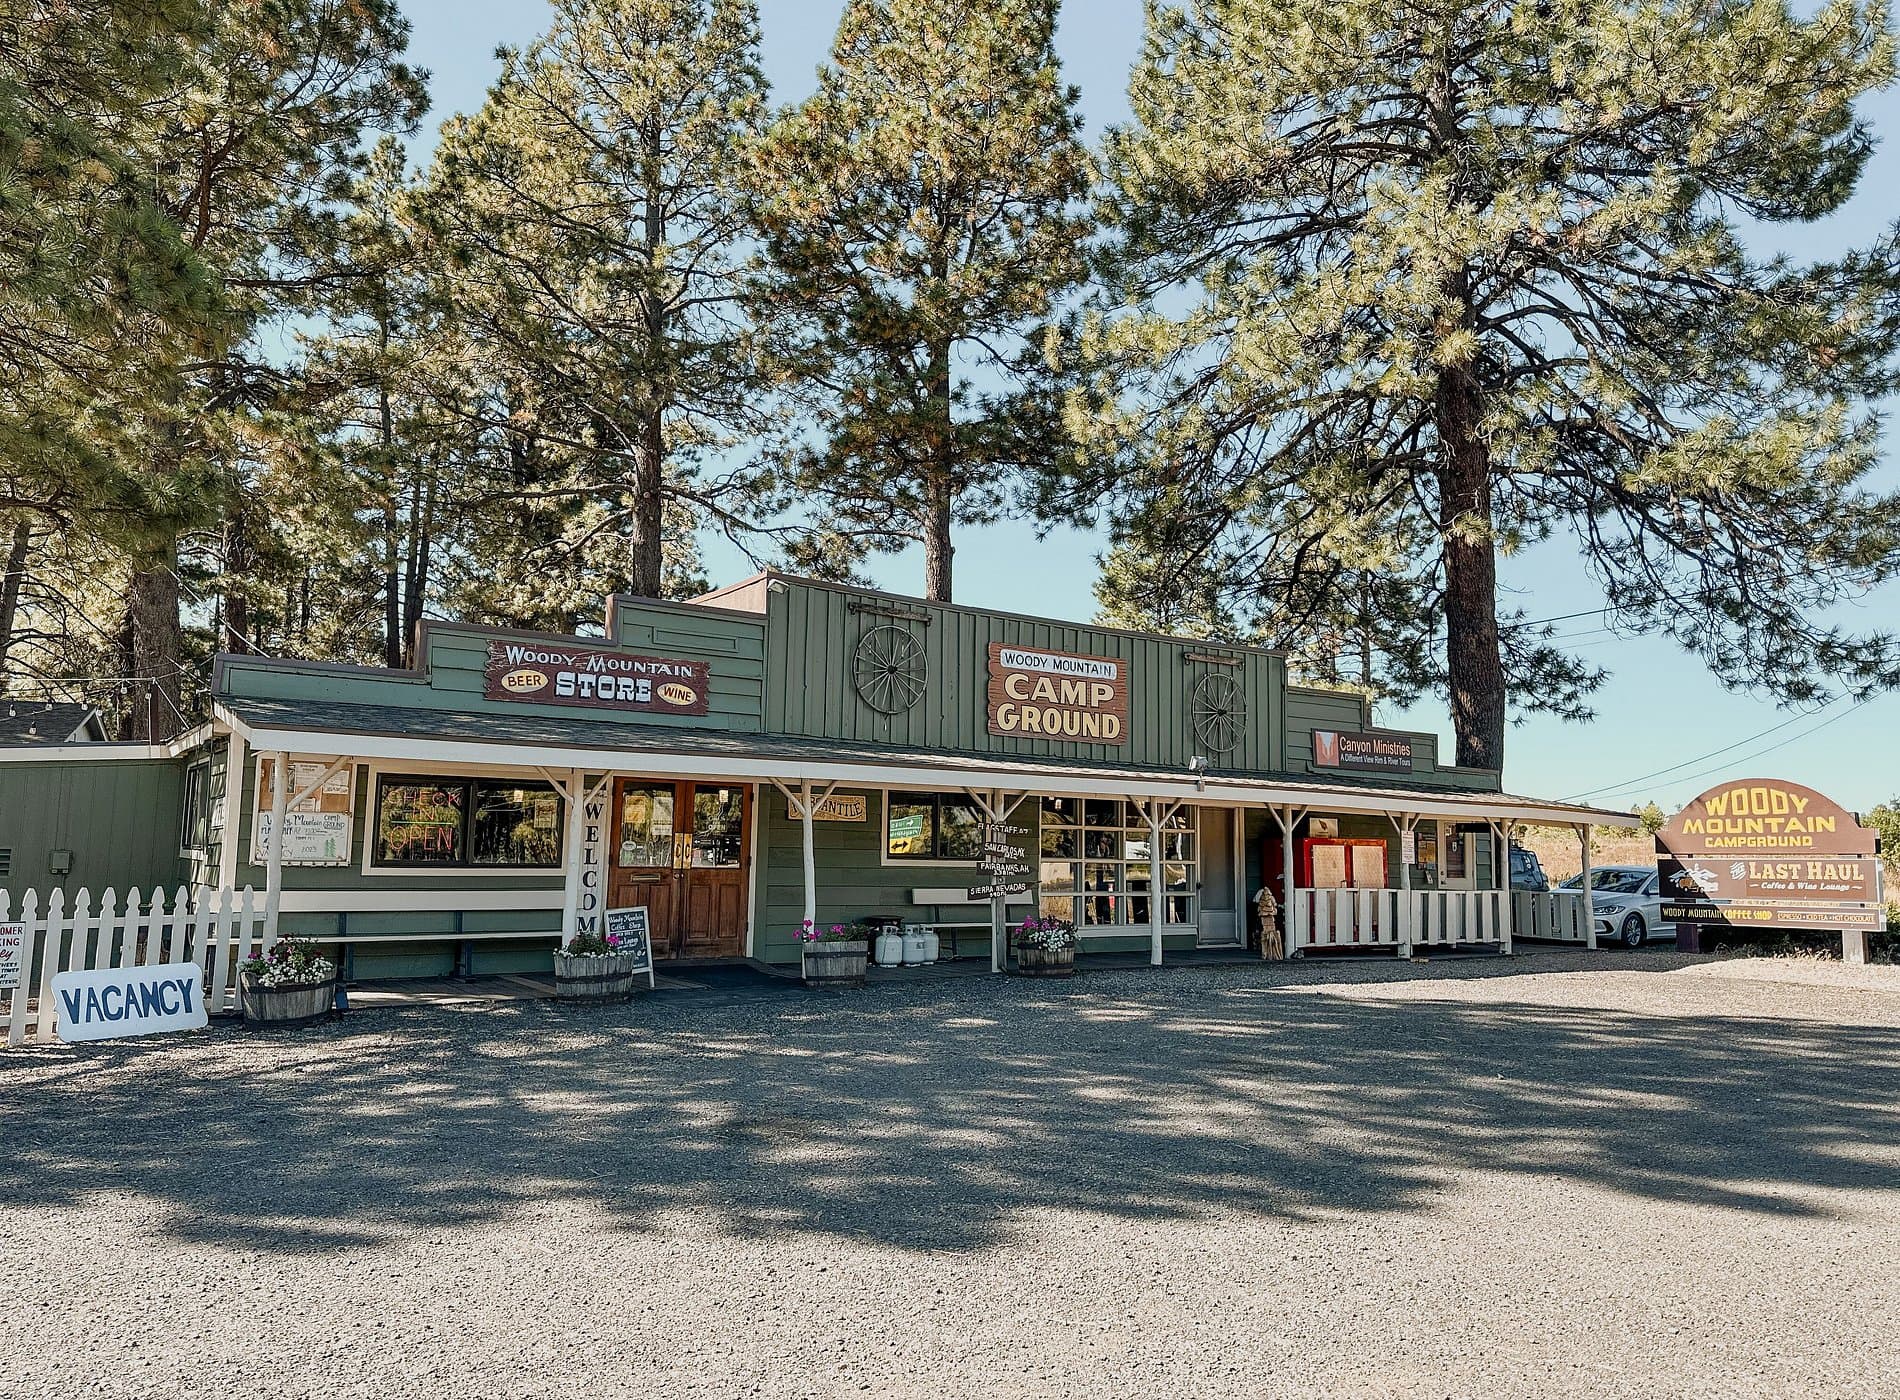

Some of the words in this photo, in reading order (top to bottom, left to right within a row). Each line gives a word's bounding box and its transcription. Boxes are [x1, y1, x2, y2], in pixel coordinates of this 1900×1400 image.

[1004, 653, 1048, 668] WOODY
[1053, 659, 1112, 677] MOUNTAIN
[507, 675, 542, 687] BEER
[556, 672, 651, 703] STORE
[663, 687, 692, 702] WINE
[1004, 673, 1115, 708] CAMP
[996, 702, 1121, 739] GROUND
[1340, 736, 1371, 755] Canyon
[1373, 739, 1411, 757] Ministries
[387, 790, 461, 808] CHECK
[1705, 787, 1809, 816] WOODY
[413, 808, 435, 821] IN
[1682, 816, 1836, 834] MOUNTAIN
[390, 826, 453, 851] OPEN
[1705, 835, 1813, 848] CAMPGROUND
[1748, 861, 1801, 880] LAST
[1806, 861, 1865, 880] HAUL
[1761, 881, 1786, 890] Coffee
[1787, 882, 1795, 890] &
[1797, 881, 1817, 890] Wine
[1819, 882, 1850, 891] Lounge
[1662, 907, 1686, 918] WOODY
[1687, 908, 1722, 919] MOUNTAIN
[1723, 909, 1752, 920] COFFEE
[1753, 911, 1773, 920] SHOP
[0, 938, 20, 947] ING
[60, 978, 194, 1024] VACANCY
